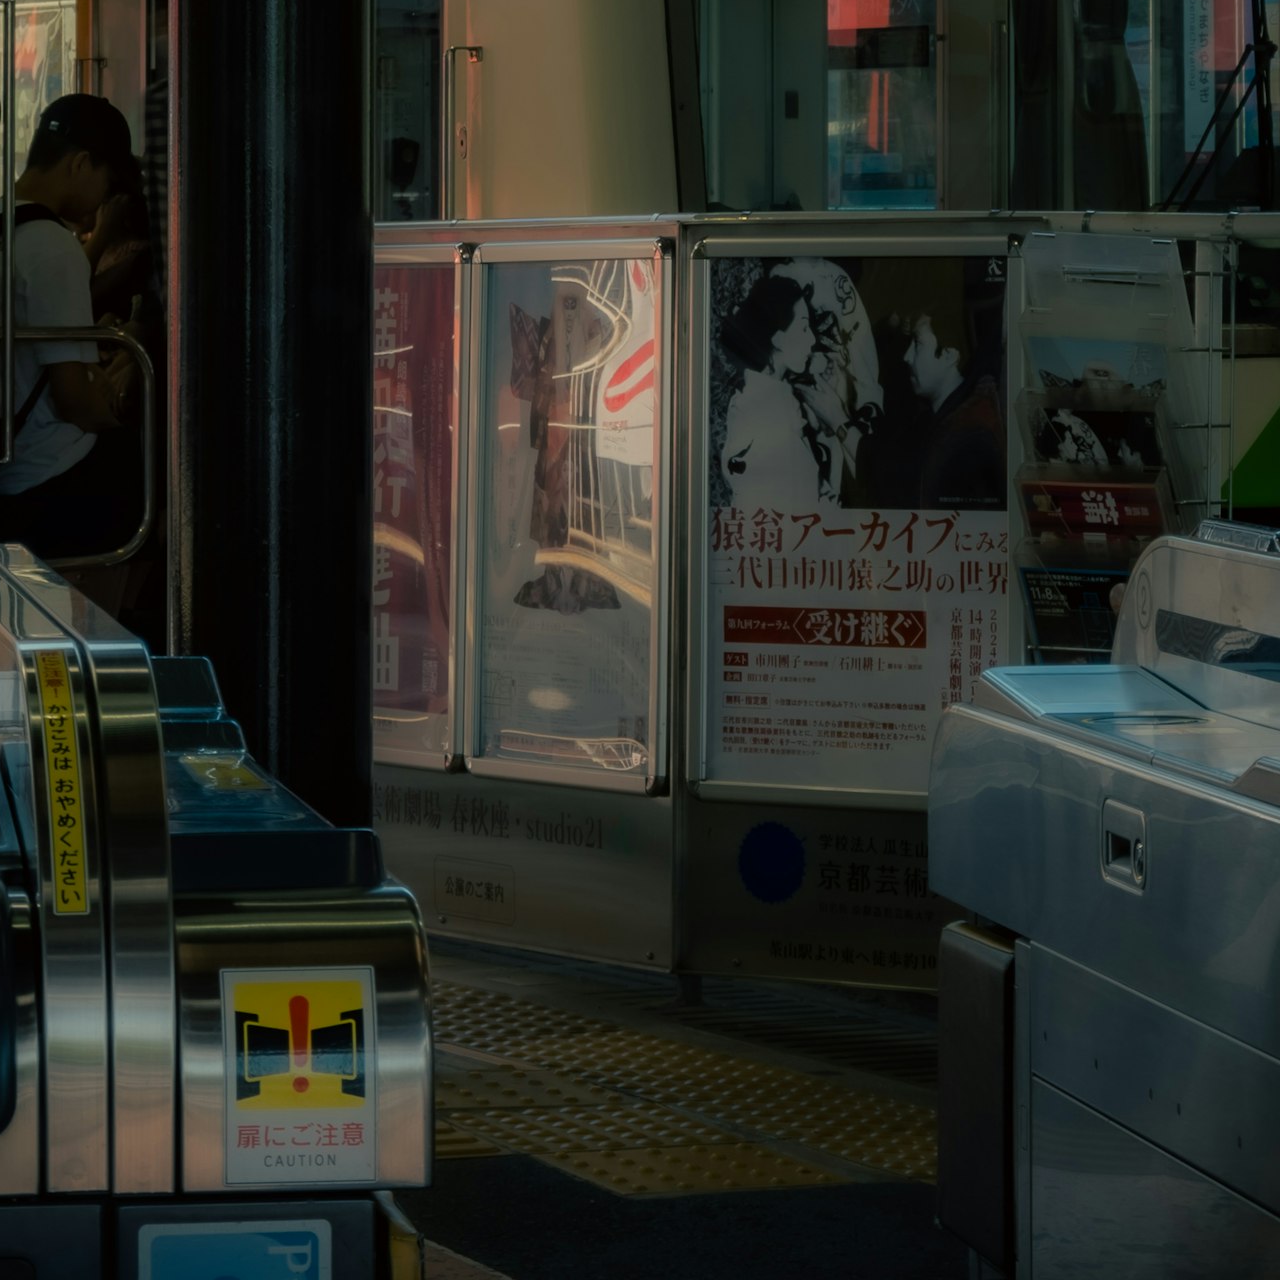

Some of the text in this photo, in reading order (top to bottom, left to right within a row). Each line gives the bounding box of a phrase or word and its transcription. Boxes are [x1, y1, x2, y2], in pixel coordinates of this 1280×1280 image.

[710, 506, 1008, 554] 猿翁アーカイブにみる
[710, 556, 1008, 594] 三代目市川猿之助の世界
[54, 777, 81, 905] おやめください
[817, 860, 939, 899] 京都芸術
[236, 1122, 365, 1149] 扉にご注意
[263, 1154, 337, 1167] CAUTION
